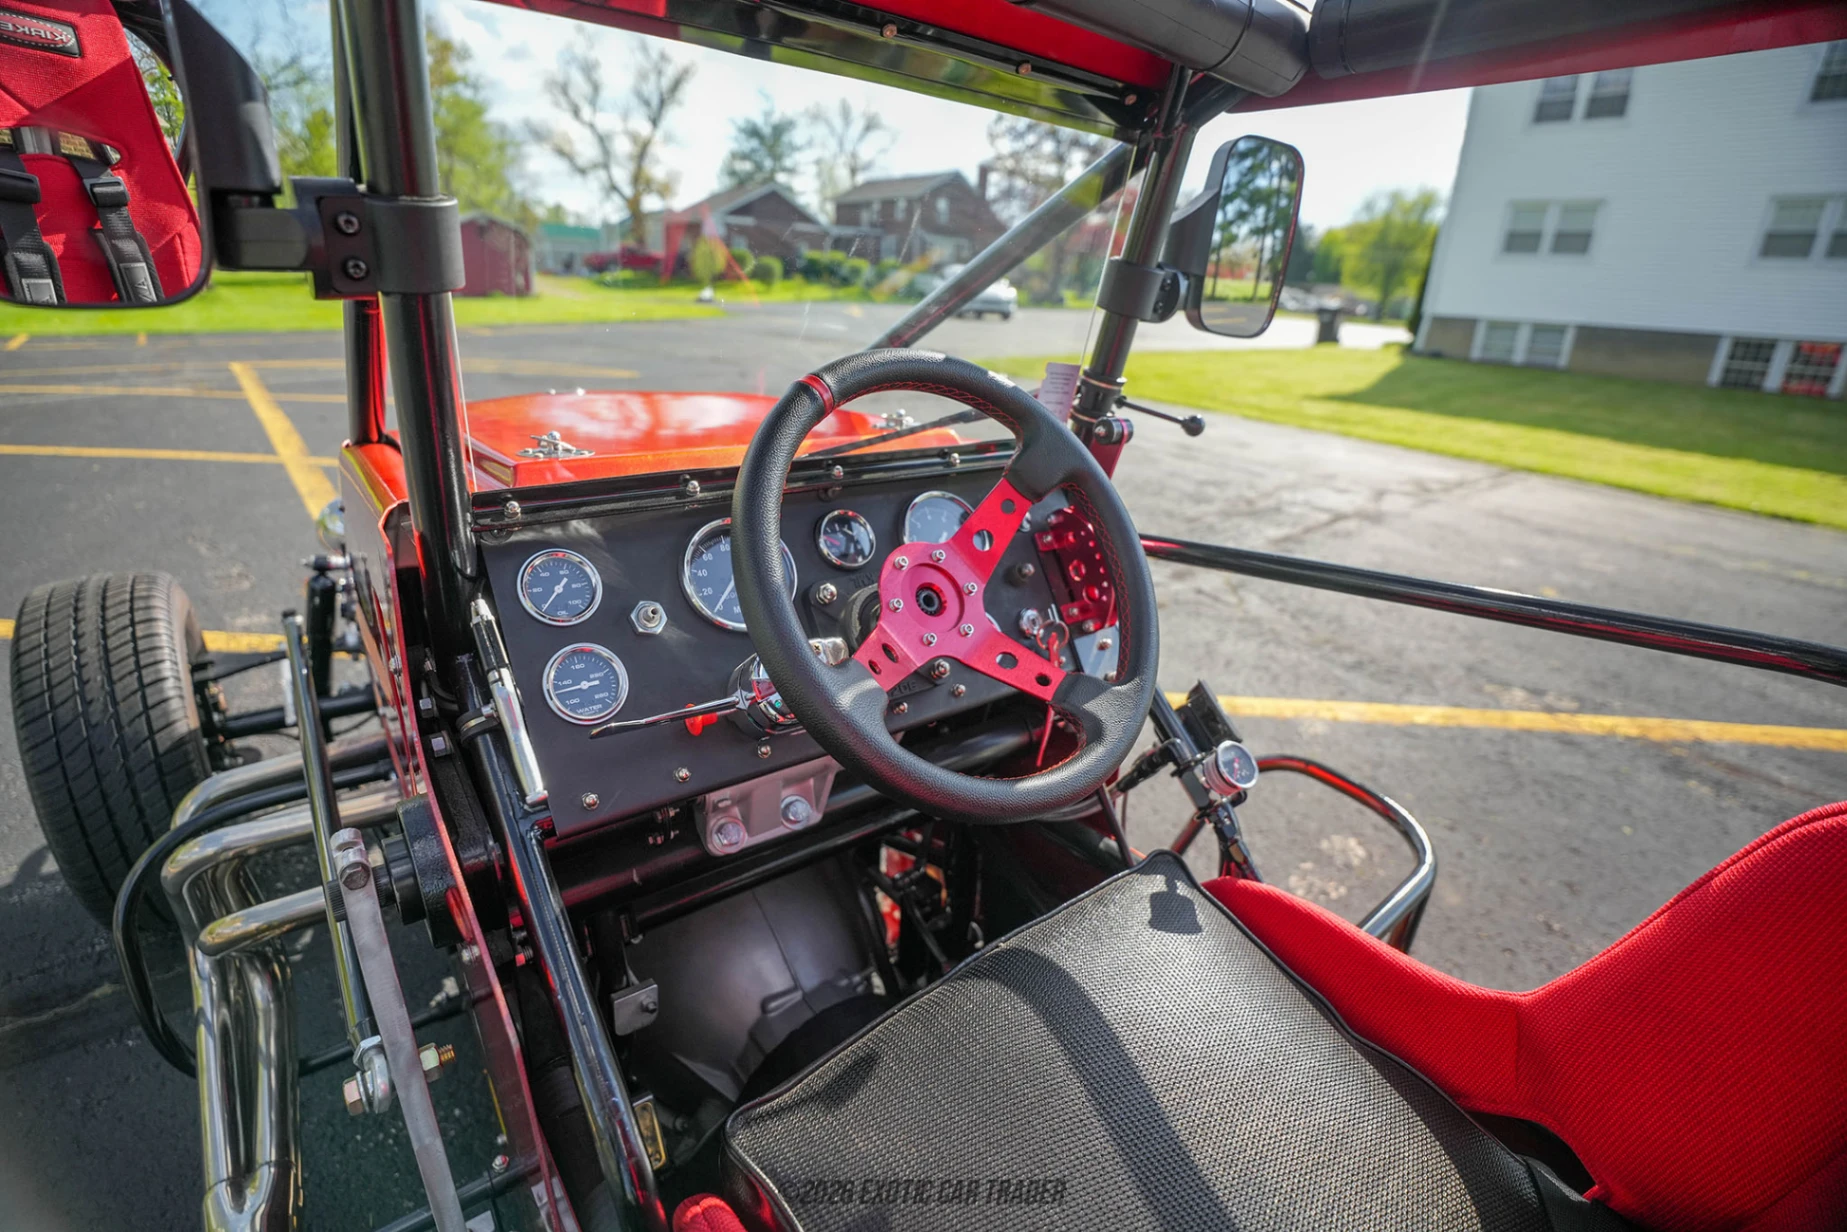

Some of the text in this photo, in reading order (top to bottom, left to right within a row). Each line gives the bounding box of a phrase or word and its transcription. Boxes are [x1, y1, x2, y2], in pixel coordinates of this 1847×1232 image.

[720, 543, 730, 552] 80
[703, 553, 713, 561] 60
[698, 569, 708, 577] 40
[702, 587, 713, 596] 20
[576, 704, 602, 714] WATER
